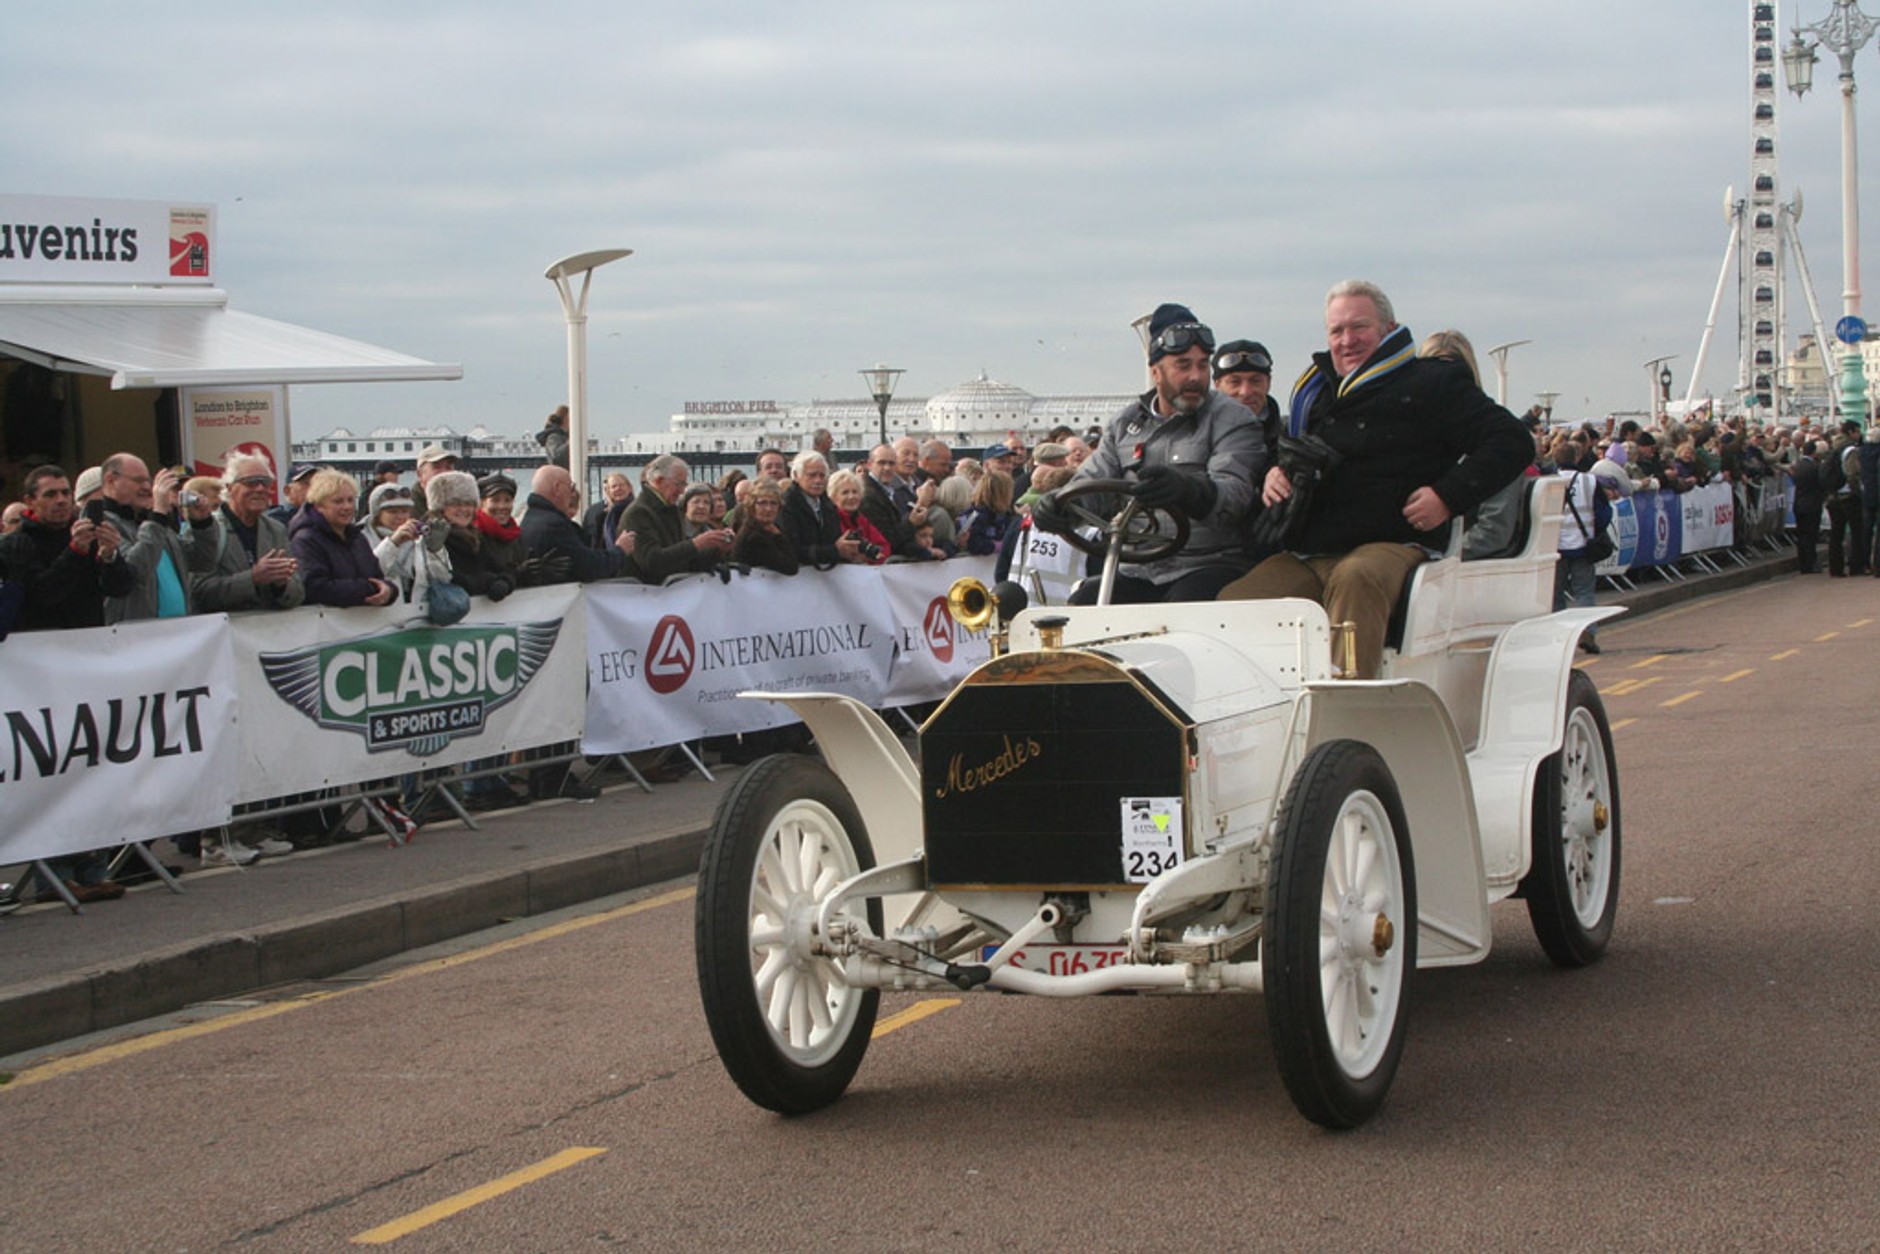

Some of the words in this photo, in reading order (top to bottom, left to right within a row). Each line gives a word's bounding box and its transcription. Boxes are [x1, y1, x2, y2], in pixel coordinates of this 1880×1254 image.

[194, 402, 225, 413] London
[226, 401, 234, 412] to
[235, 400, 269, 414] Brighton
[194, 416, 227, 427] Veteran
[228, 414, 243, 426] Car
[244, 414, 262, 425] Run
[684, 401, 745, 414] BRIGHTON
[749, 400, 777, 413] PIER
[1030, 539, 1059, 558] 253
[599, 648, 639, 684] EFG
[700, 623, 872, 672] INTERNATIONAL
[323, 634, 518, 718] CLASSIC
[0, 686, 211, 783] NAULT
[374, 718, 388, 739] &
[390, 711, 448, 737] SPORTS
[449, 704, 481, 727] CAR
[936, 734, 1042, 799] Mercedes
[1129, 850, 1178, 877] 234
